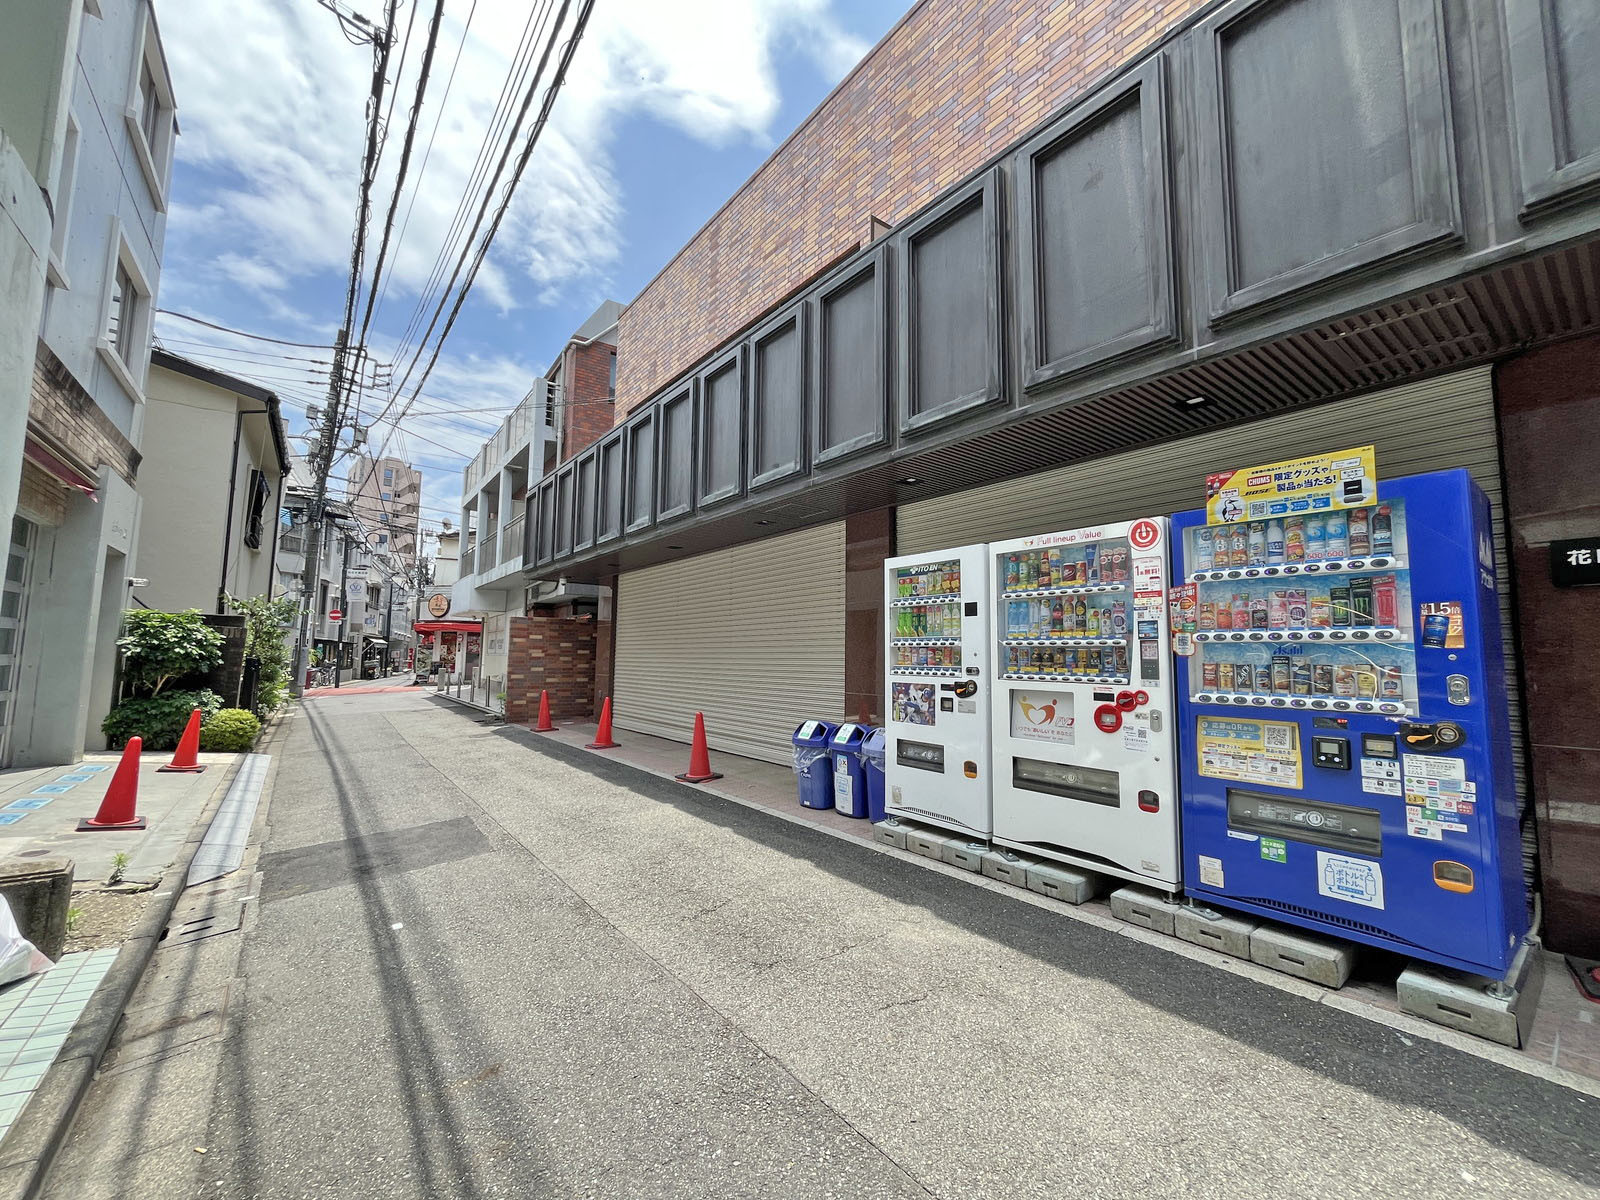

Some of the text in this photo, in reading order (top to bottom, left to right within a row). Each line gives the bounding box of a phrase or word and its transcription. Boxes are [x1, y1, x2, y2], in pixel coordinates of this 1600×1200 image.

[1248, 475, 1271, 486] CHUMS
[1273, 466, 1329, 481] 限定グッズや
[1277, 474, 1337, 493] 製品が当たる!
[1037, 529, 1102, 546] Full lineup Value
[1567, 549, 1600, 566] 花
[1273, 645, 1303, 656] Asahi
